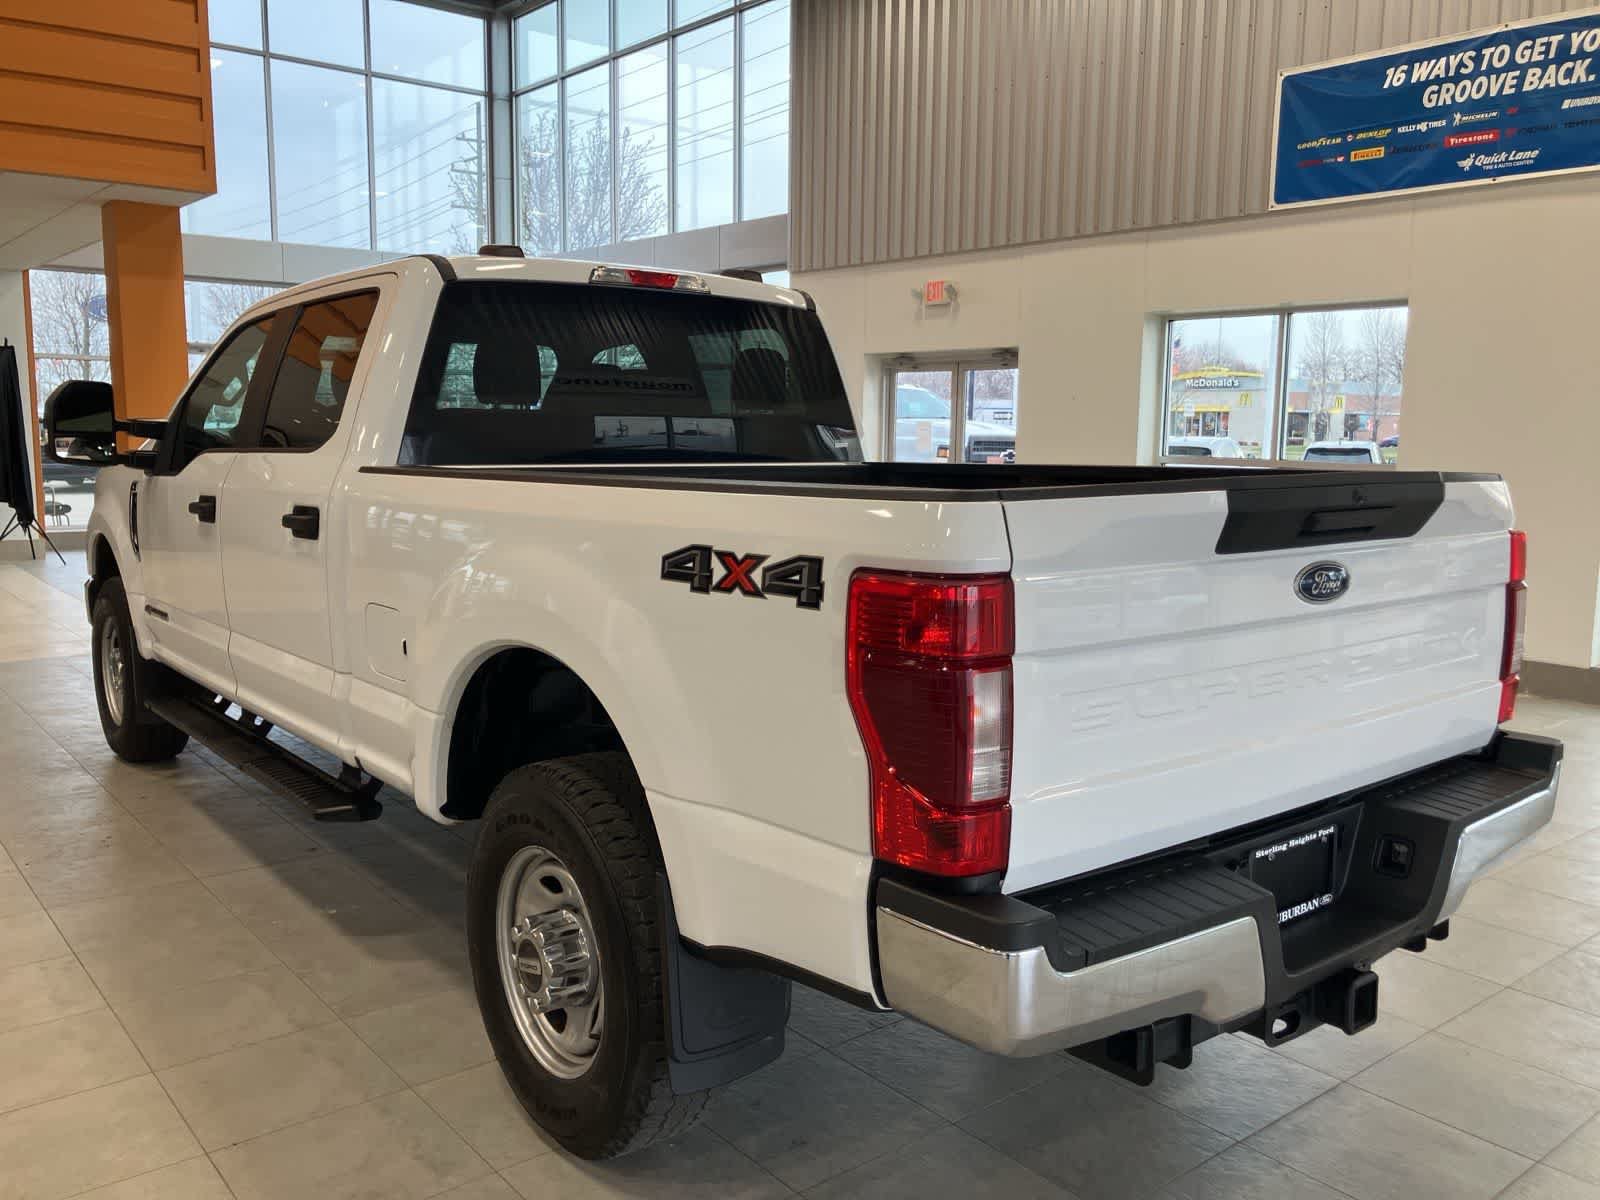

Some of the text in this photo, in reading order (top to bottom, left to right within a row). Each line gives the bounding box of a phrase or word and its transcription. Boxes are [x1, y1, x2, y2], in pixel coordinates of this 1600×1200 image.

[1382, 65, 1409, 89] 16
[1410, 50, 1476, 83] WAYS
[1480, 44, 1511, 71] TO
[1514, 34, 1565, 64] GET
[1422, 58, 1596, 109] GROOVE BACK.
[1297, 137, 1342, 151] GOODYEAR
[1356, 128, 1392, 139] DUNLOP
[1397, 124, 1416, 134] KELLY
[1428, 119, 1447, 129] TIRES
[1461, 111, 1498, 121] MICHELIN
[1450, 132, 1495, 146] Firestone
[1474, 149, 1540, 166] Quick Lane
[926, 280, 945, 301] EXIT
[1186, 377, 1240, 388] McDonald's
[1311, 570, 1341, 595] Ford
[1255, 825, 1335, 858] Sterling Heights Ford
